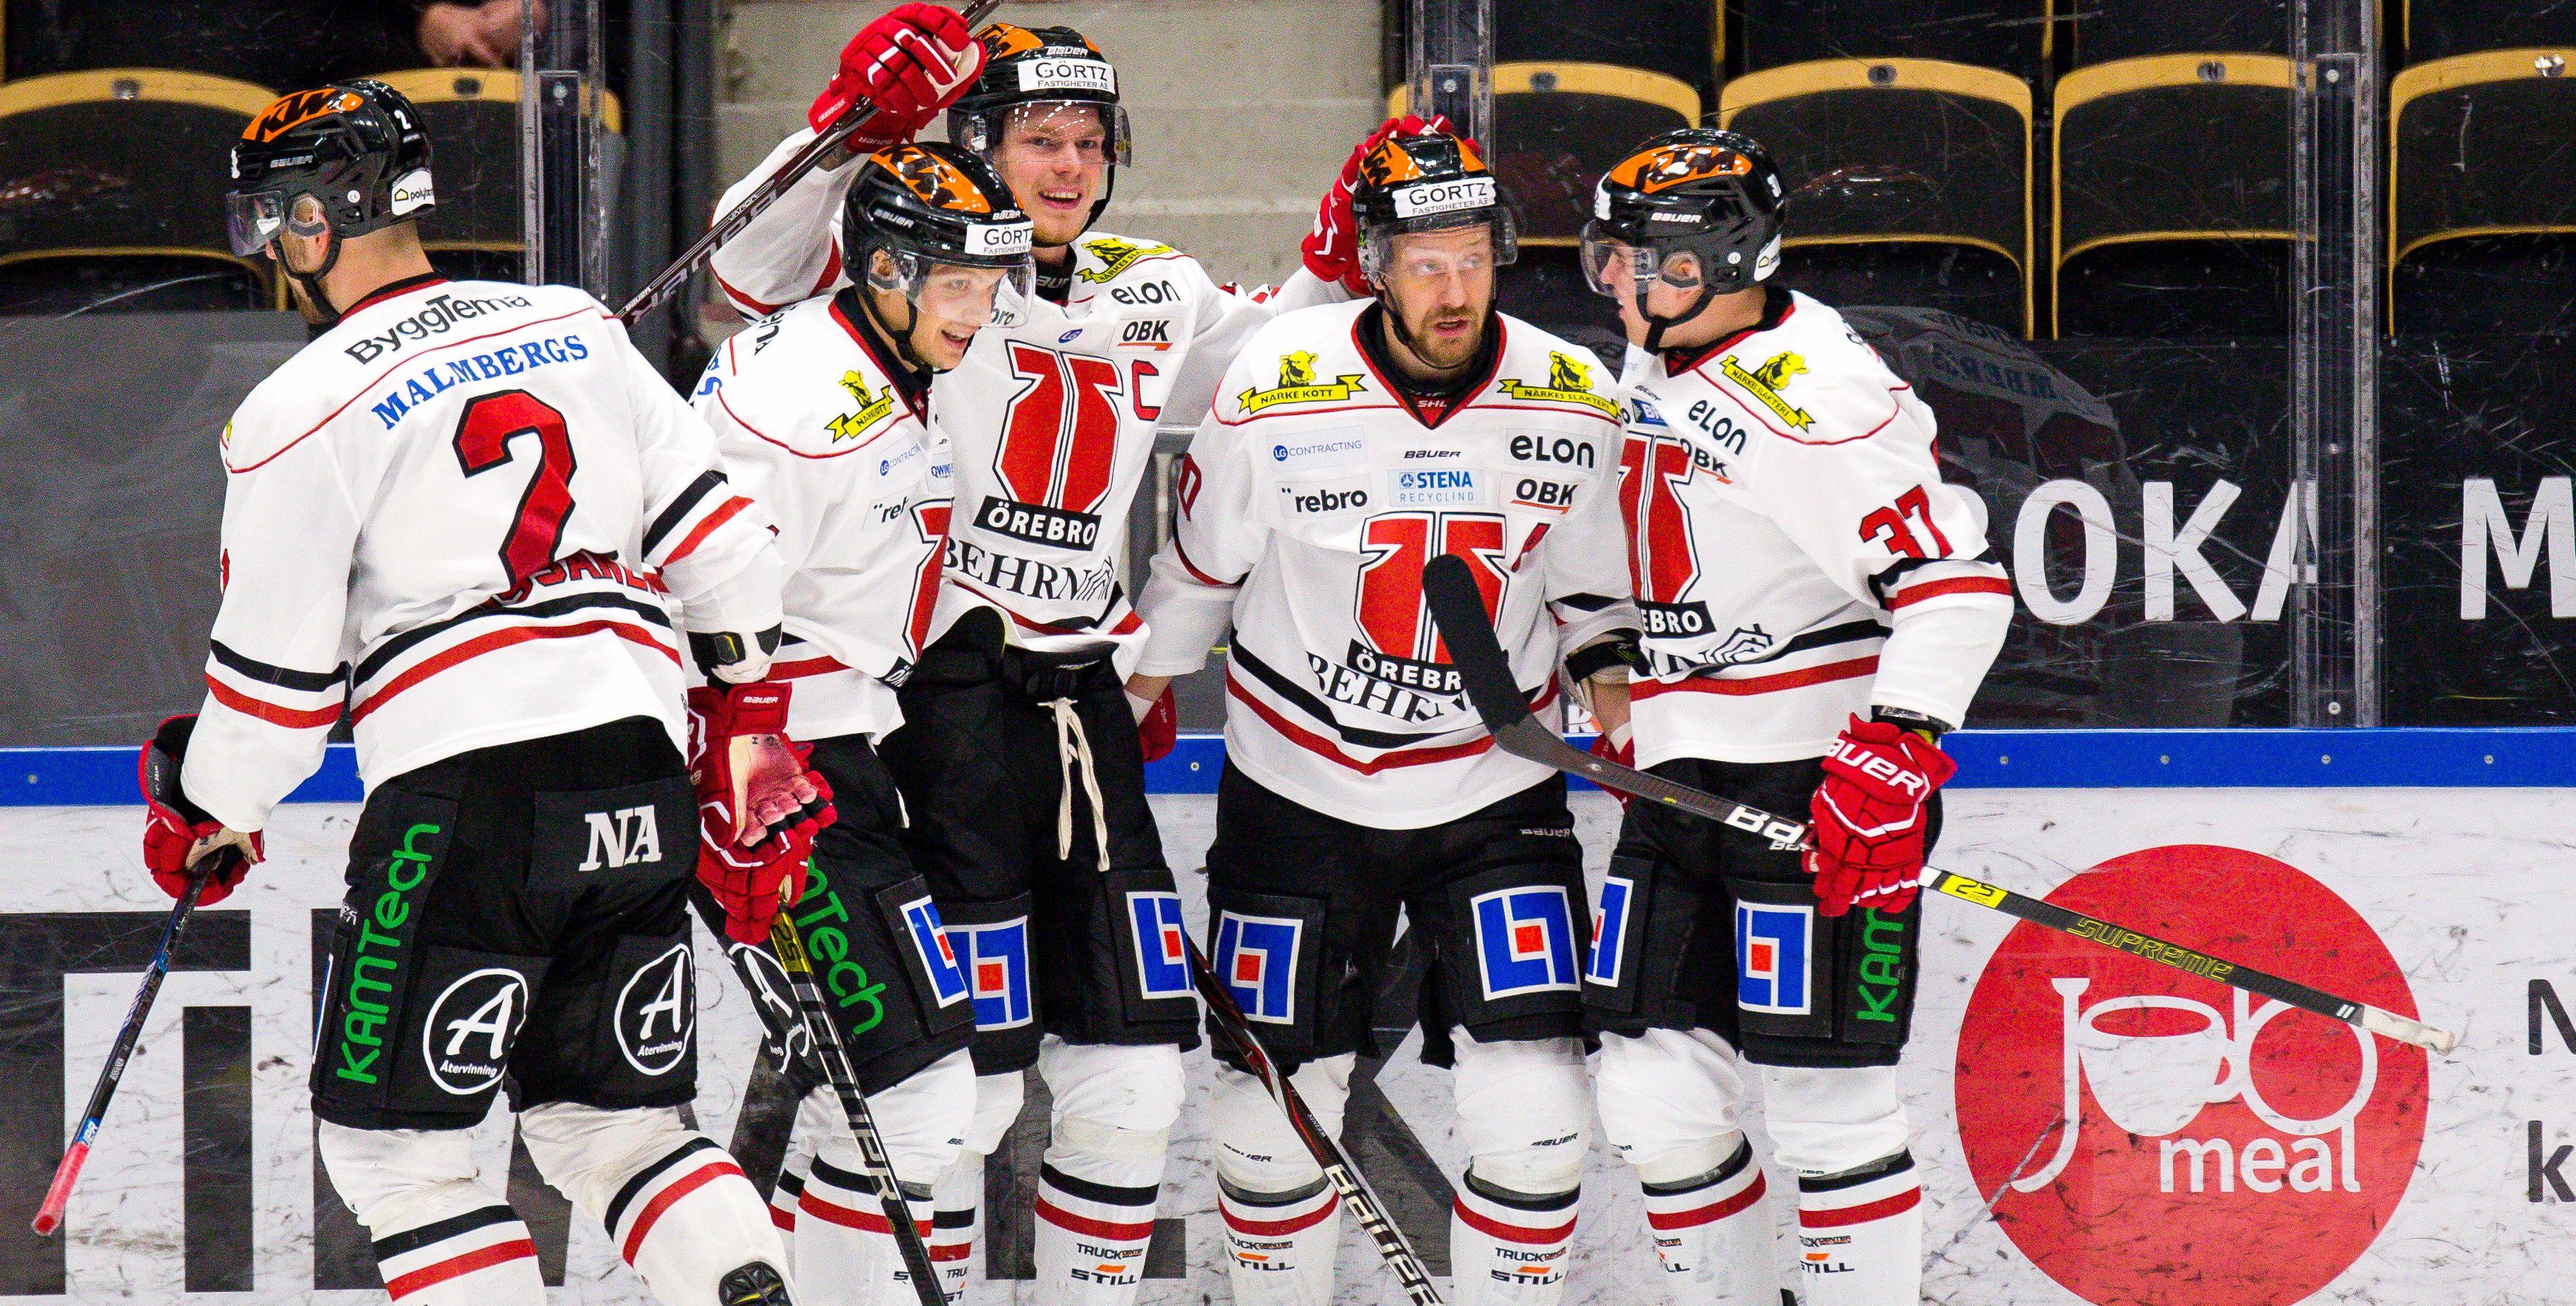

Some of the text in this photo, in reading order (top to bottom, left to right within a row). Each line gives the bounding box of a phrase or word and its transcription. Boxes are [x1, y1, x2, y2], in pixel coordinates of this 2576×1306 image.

[1035, 61, 1108, 82] GÖRTZ
[1037, 80, 1097, 89] FASTIGHETER
[1410, 183, 1487, 206] GÖRTZ
[1412, 200, 1475, 216] FASTIGHETER
[1122, 320, 1171, 343] OBK
[371, 334, 589, 431] MALMBERGS
[1289, 440, 1363, 457] CONTRACTING
[1403, 450, 1461, 459] BAUER
[1417, 472, 1473, 489] STENA
[1400, 493, 1474, 503] RECYCLING
[1516, 479, 1579, 506] OBK
[988, 501, 1097, 546] ÖREBRO
[1858, 483, 1954, 560] 37
[1641, 609, 1703, 634] EBRO
[1355, 648, 1462, 691] ÖREBR
[742, 696, 779, 704] BAUER
[1825, 737, 1925, 797] AUER
[579, 803, 663, 872] NA
[2066, 916, 2236, 983] SUPREME
[2159, 1133, 2362, 1194] meal
[1076, 1243, 1122, 1260] TRUCK
[1495, 1246, 1543, 1262] TRUCK
[1071, 1268, 1138, 1286] STILL
[1490, 1269, 1563, 1286] STILL
